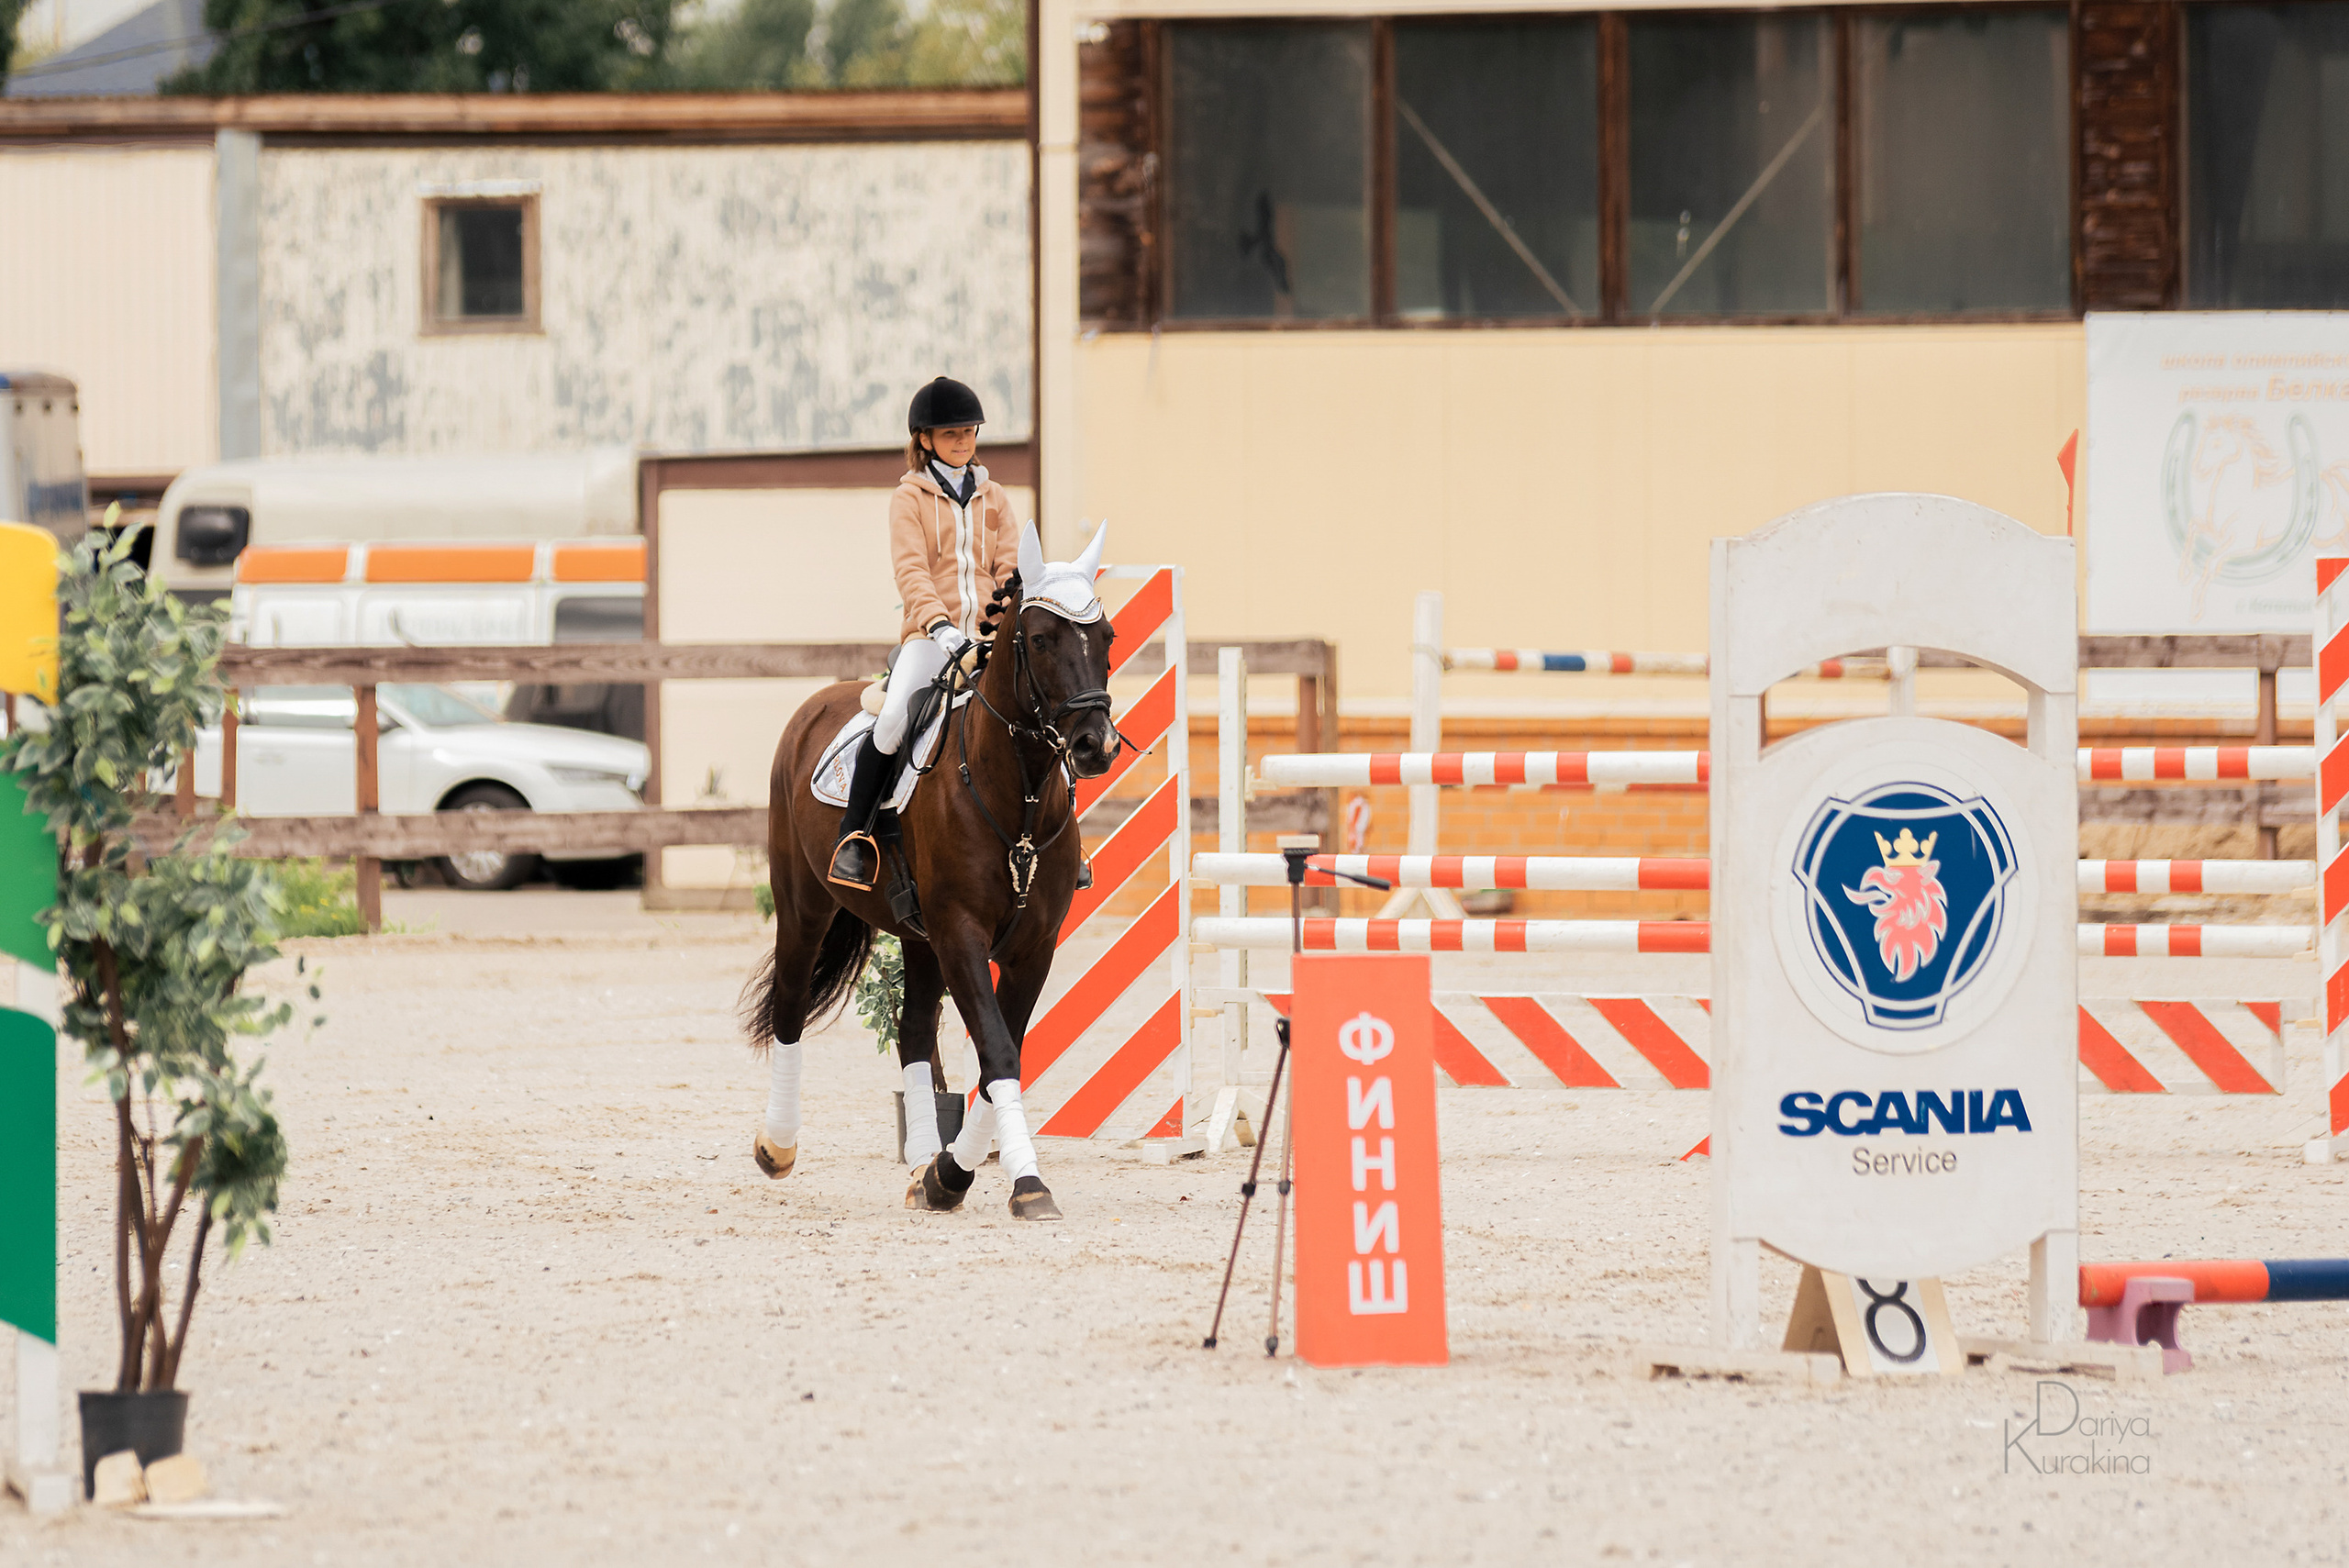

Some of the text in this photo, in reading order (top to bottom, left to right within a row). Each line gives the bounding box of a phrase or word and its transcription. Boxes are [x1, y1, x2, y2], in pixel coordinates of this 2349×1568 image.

[1777, 1088, 2032, 1138] SCANIA
[1339, 1011, 1408, 1316] ФИНИШ
[1852, 1146, 1958, 1176] Service
[1856, 1278, 1927, 1365] 8
